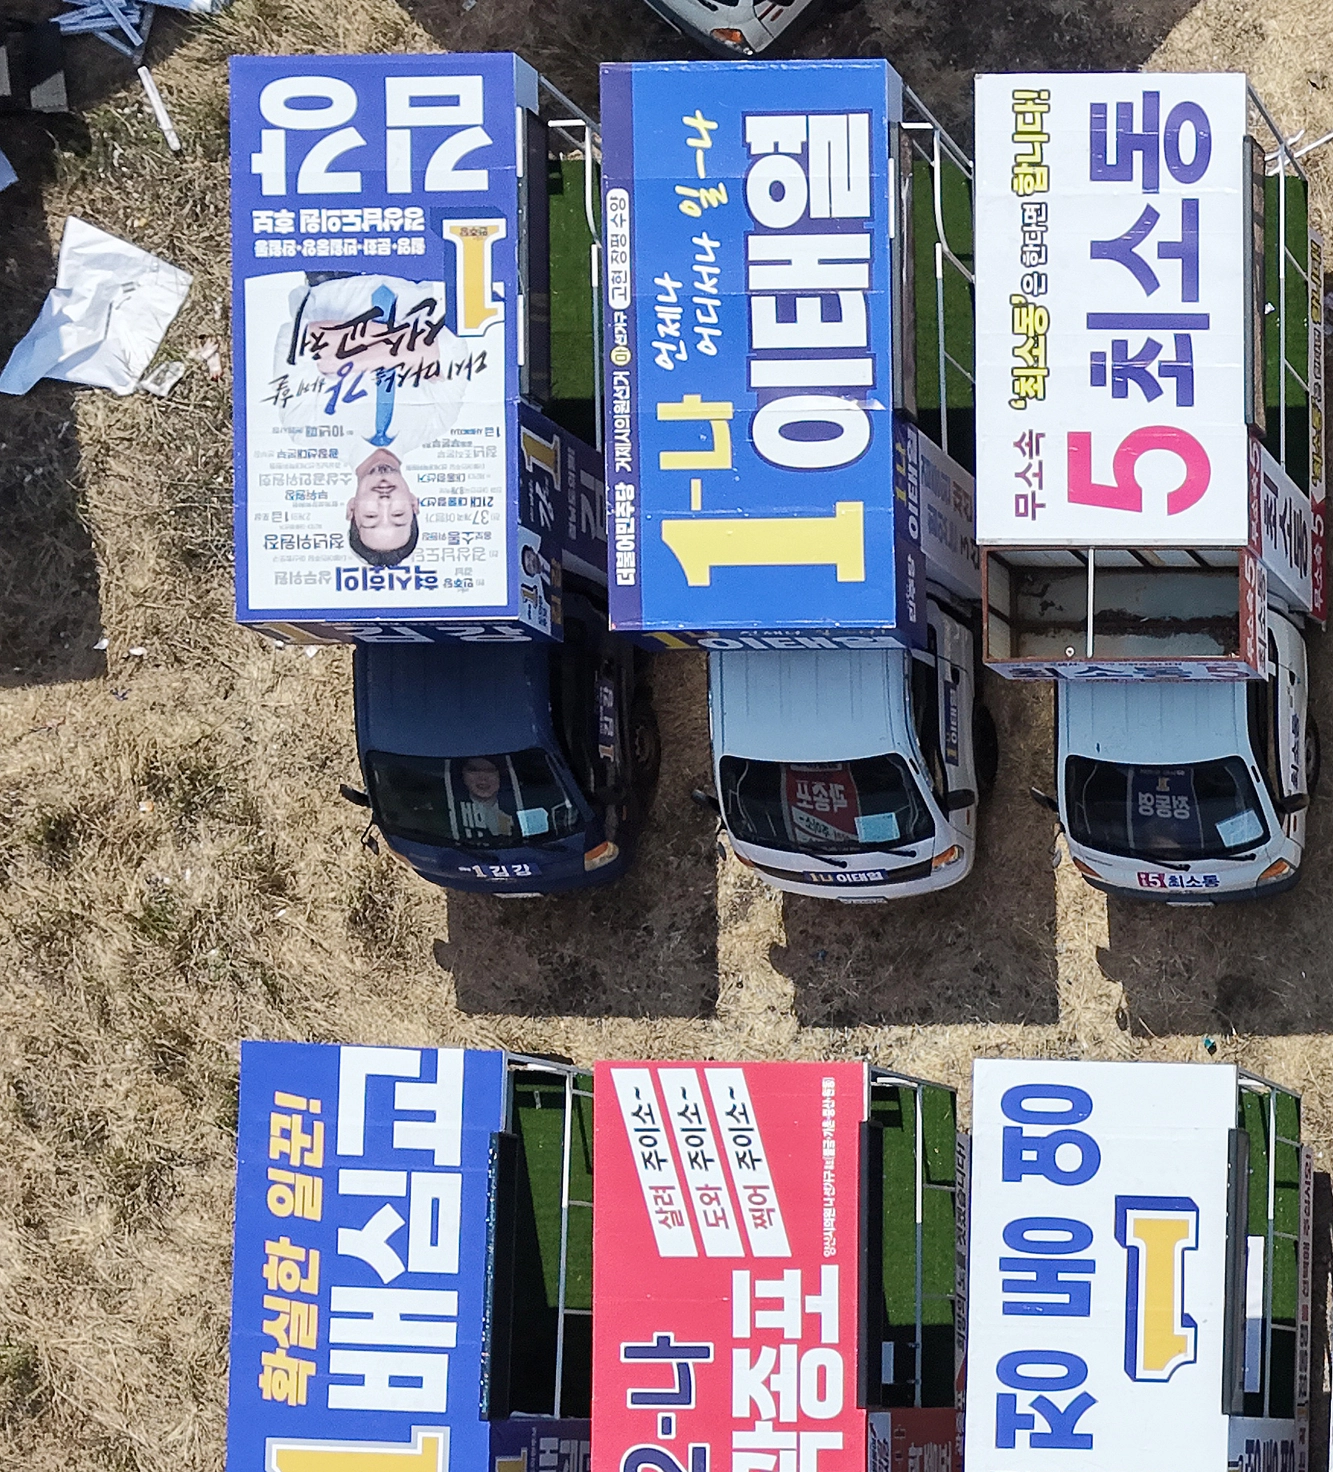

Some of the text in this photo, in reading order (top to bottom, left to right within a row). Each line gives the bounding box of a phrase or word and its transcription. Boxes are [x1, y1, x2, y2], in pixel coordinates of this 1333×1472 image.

[251, 74, 494, 196] 김강
[252, 207, 426, 234] 경상남도의원 후보
[608, 195, 627, 228] 수양
[608, 232, 627, 266] 장평
[442, 219, 507, 337] 1
[608, 269, 627, 302] 고현
[651, 273, 688, 370] 언제나
[746, 112, 873, 469] 이태열
[1068, 91, 1212, 516] 5 최소동
[613, 371, 632, 473] 거제시의원선거
[263, 534, 344, 549] 청년위원장
[274, 571, 331, 585] 상무위원
[335, 566, 439, 591] 혁신회의
[614, 482, 636, 585] 더불어민주당
[257, 1091, 324, 1405] 확실한 일꾼!
[327, 1046, 465, 1413] 배심교
[995, 1082, 1101, 1450] 정동영
[1114, 1196, 1198, 1383] 1
